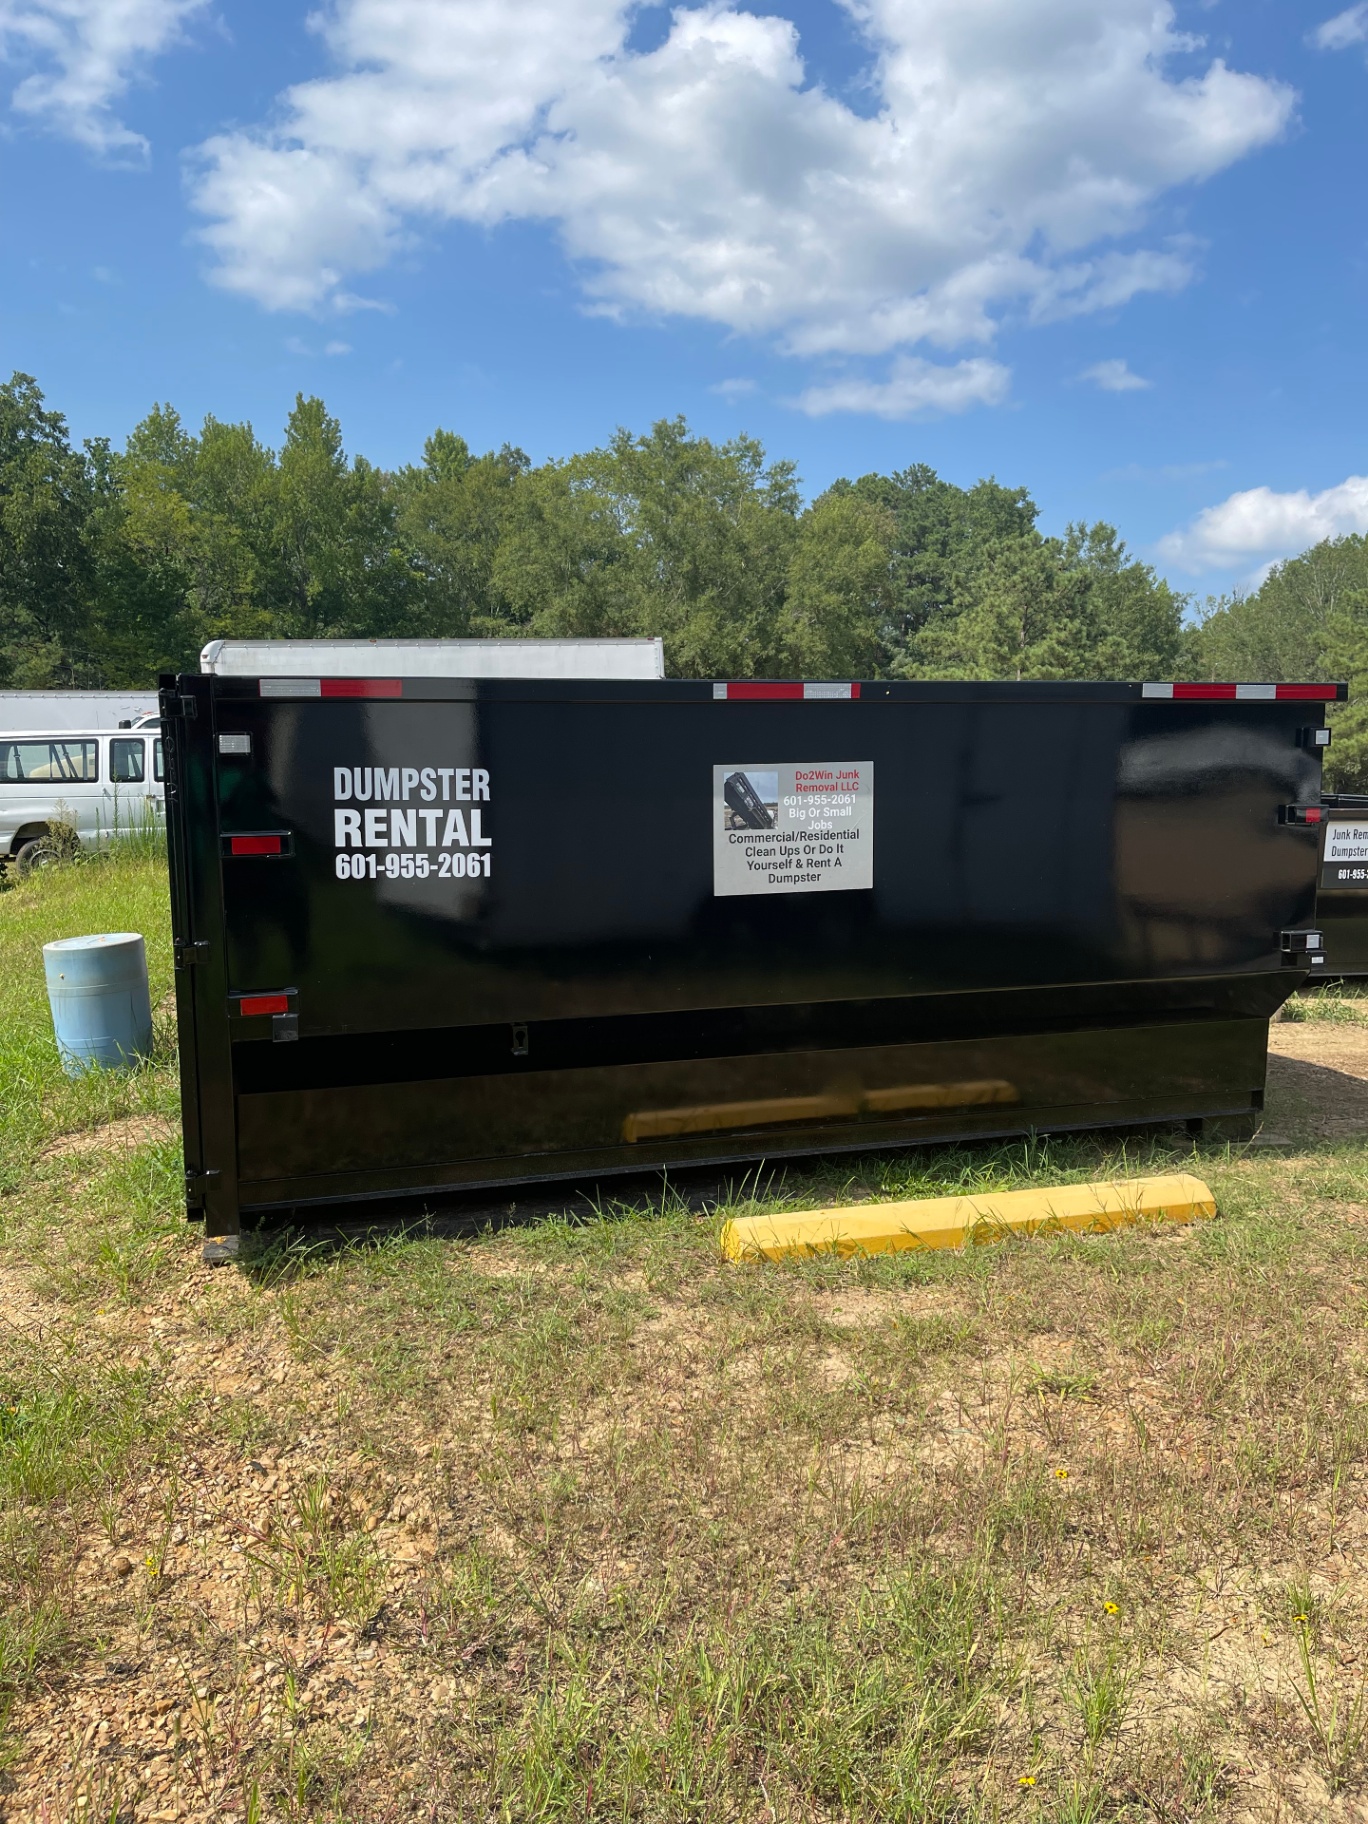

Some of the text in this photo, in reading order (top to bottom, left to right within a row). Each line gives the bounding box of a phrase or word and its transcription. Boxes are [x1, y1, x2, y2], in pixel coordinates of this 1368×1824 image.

[795, 769, 860, 781] Do2Win Junk
[334, 767, 490, 801] DUMPSTER
[795, 781, 859, 792] Removal LLC
[783, 794, 856, 806] 601-955-2061
[789, 806, 852, 819] Big Or Small
[334, 808, 492, 847] RENTAL
[808, 820, 833, 830] Jobs
[728, 829, 860, 844] Commercial/Residential
[1332, 829, 1351, 840] Junk
[745, 843, 844, 858] Clean Ups Or Do It
[1331, 845, 1368, 859] Dumpster
[335, 852, 491, 879] 601-955-2061
[747, 857, 842, 870] Yourself & Rent A
[768, 872, 821, 884] Dumpster
